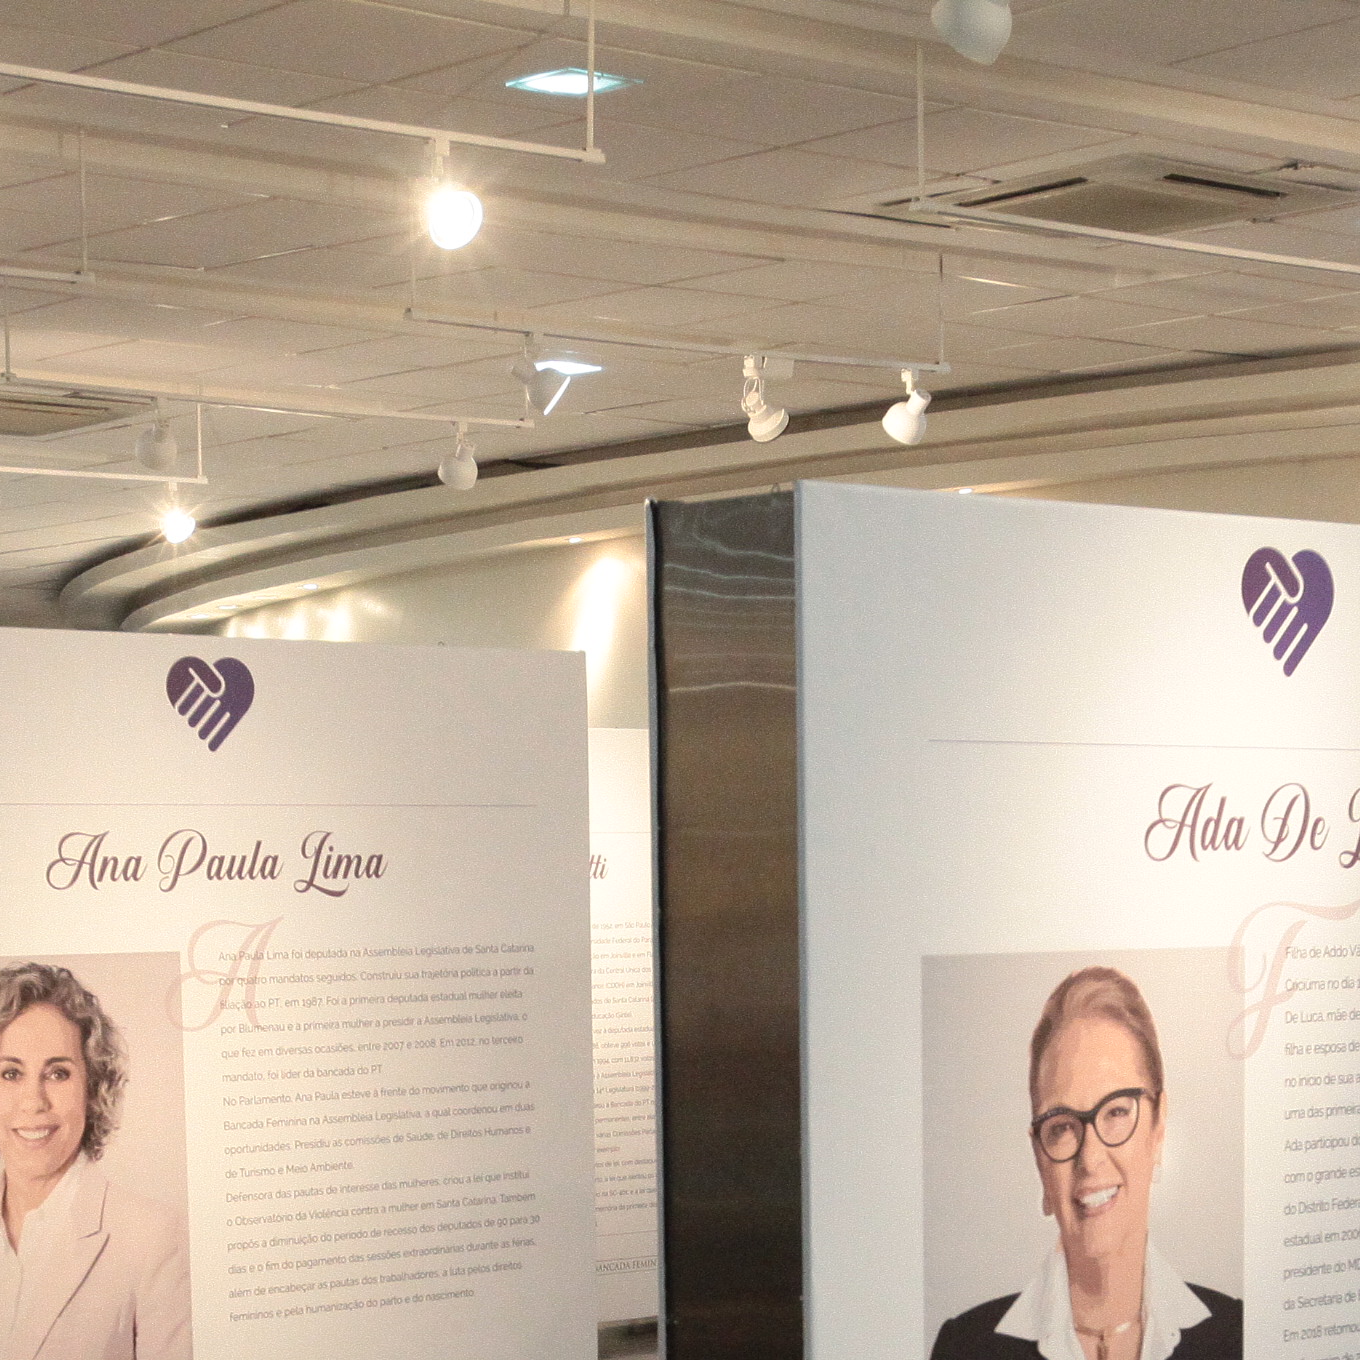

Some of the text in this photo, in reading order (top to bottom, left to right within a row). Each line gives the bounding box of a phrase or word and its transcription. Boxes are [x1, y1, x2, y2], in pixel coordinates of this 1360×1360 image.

[1143, 782, 1251, 862] Ada
[1261, 782, 1330, 862] De
[45, 829, 388, 897] Ana Paula Lima
[217, 951, 236, 961] Ana
[290, 948, 302, 959] foi
[349, 949, 360, 957] na
[461, 944, 473, 954] de
[220, 1026, 236, 1036] por
[222, 1096, 236, 1106] No
[294, 1092, 313, 1102] Ana
[408, 1085, 419, 1095] do
[471, 1083, 488, 1093] que
[309, 1117, 320, 1125] na
[499, 1104, 512, 1112] em
[224, 1168, 237, 1178] de
[294, 1210, 306, 1220] da
[420, 1202, 434, 1210] em
